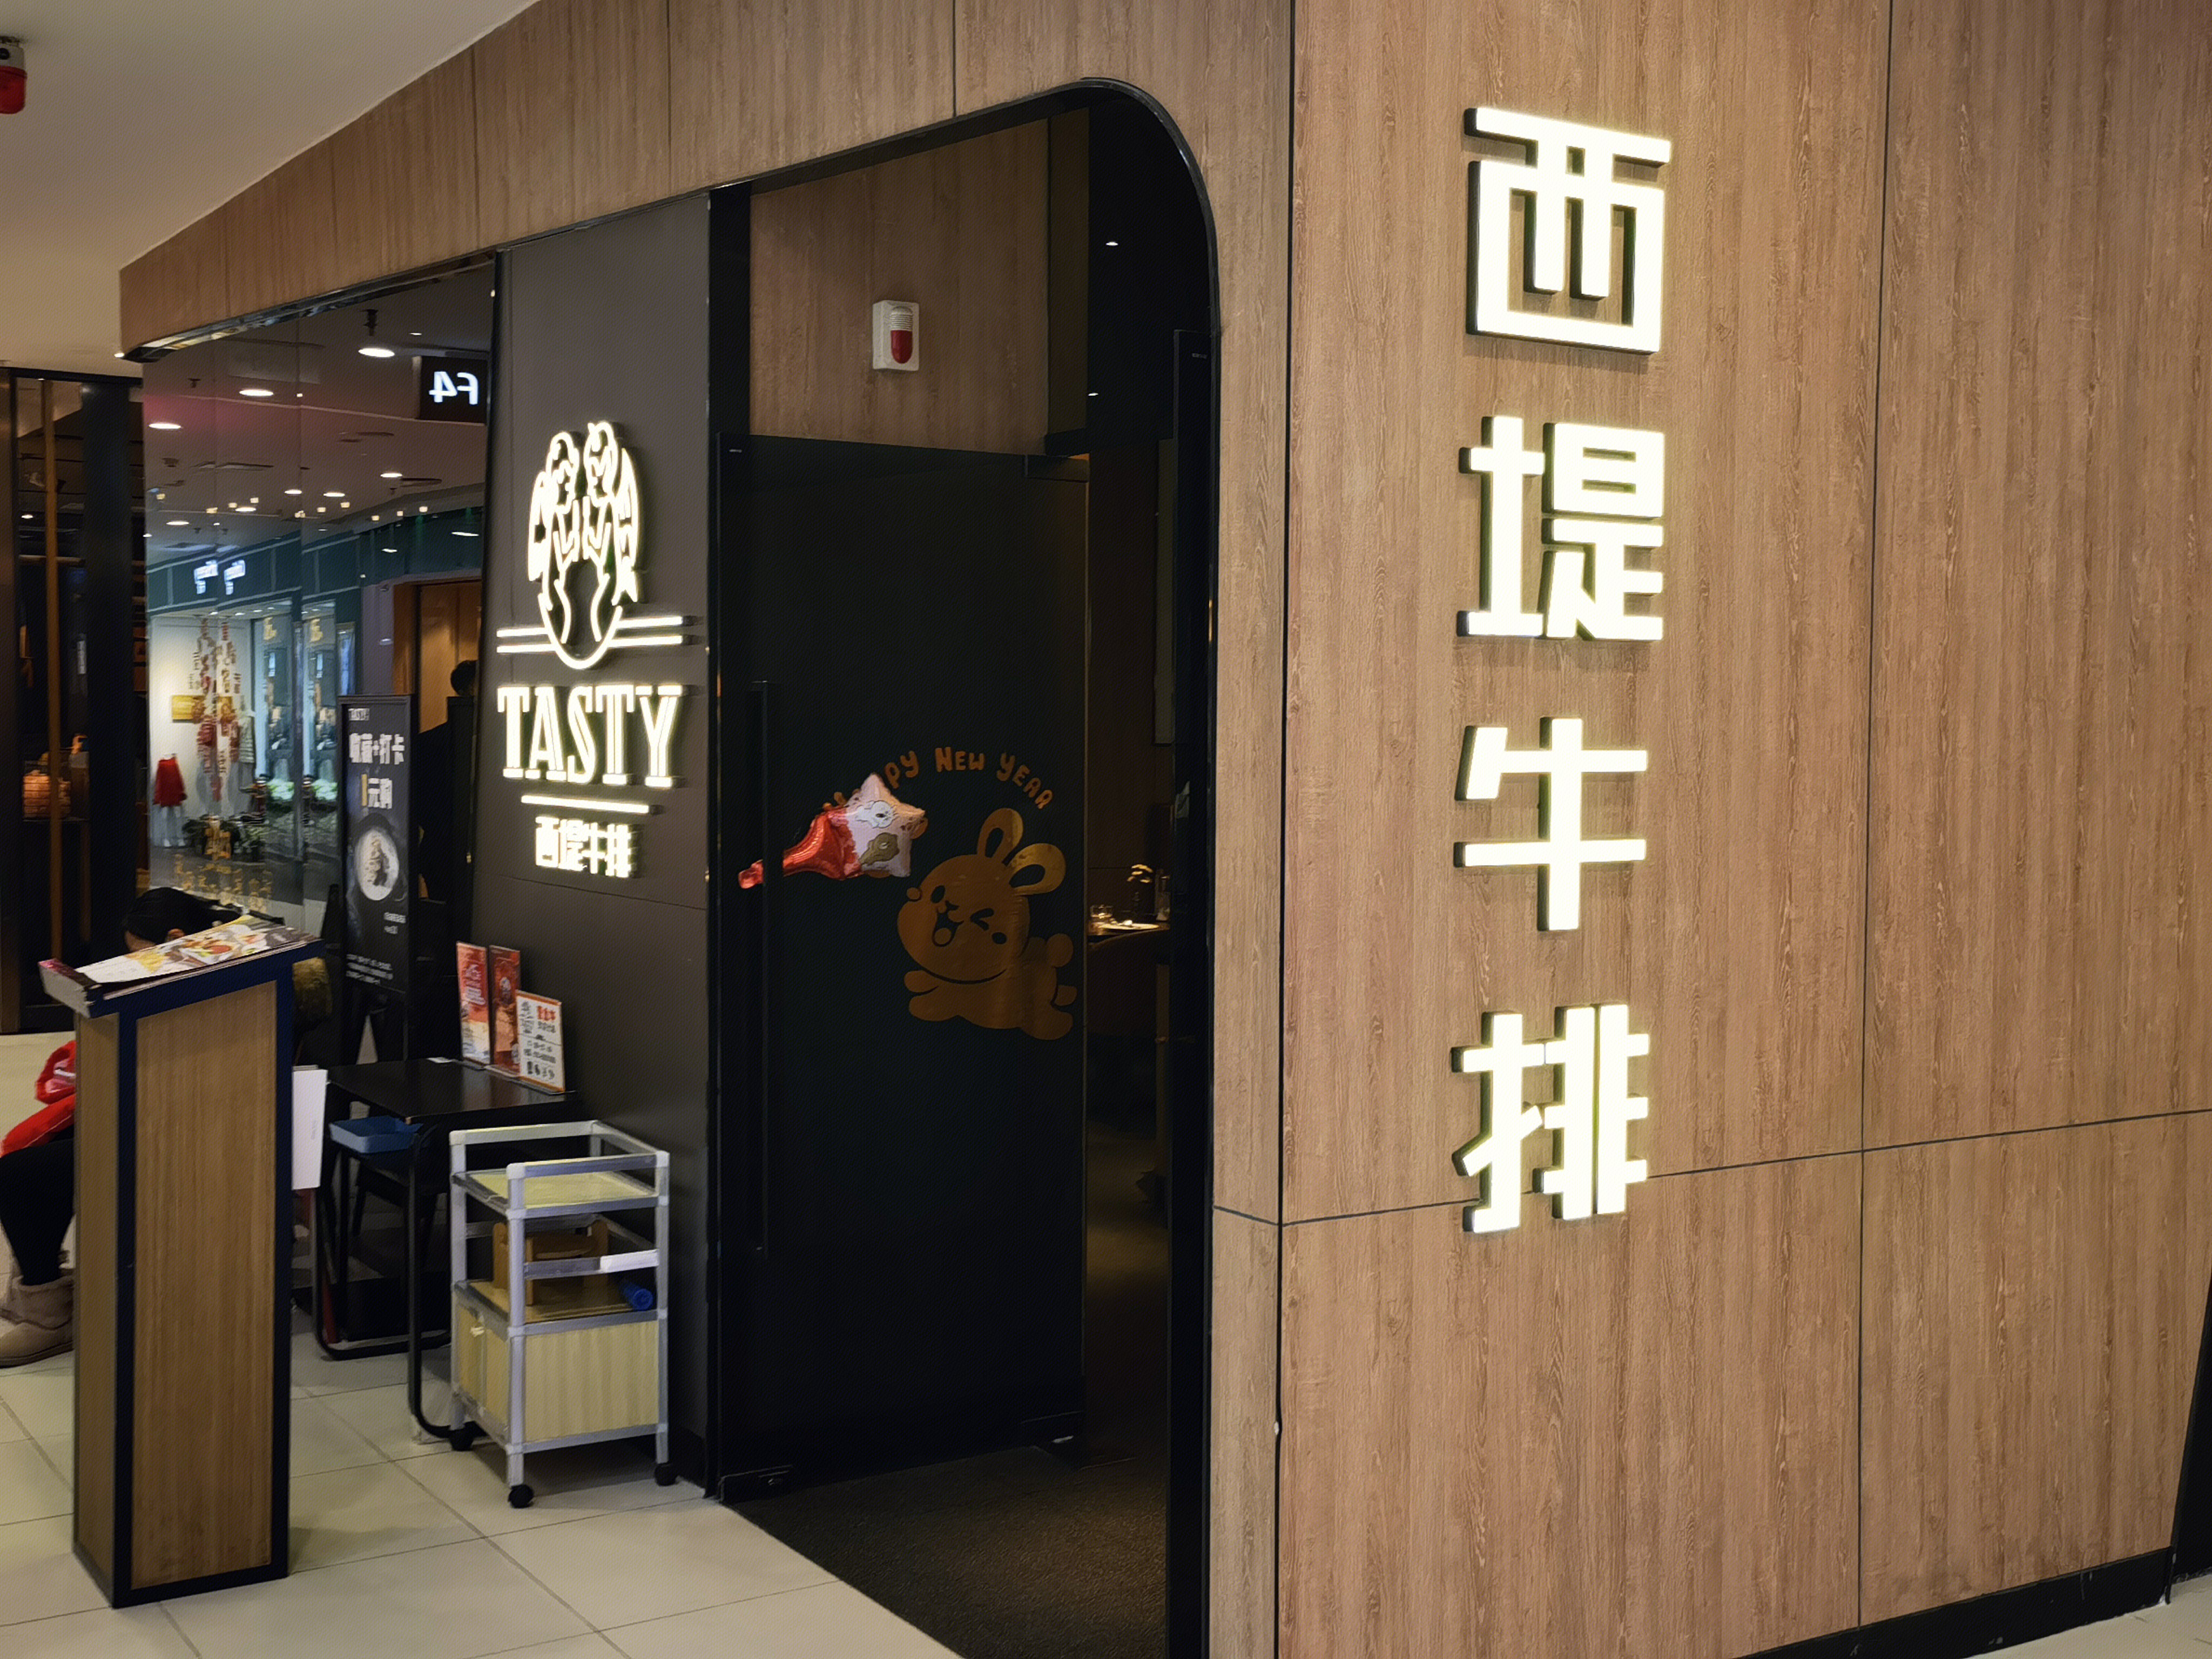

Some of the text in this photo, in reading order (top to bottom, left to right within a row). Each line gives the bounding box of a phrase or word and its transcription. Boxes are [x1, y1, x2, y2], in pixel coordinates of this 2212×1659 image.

[1456, 106, 1671, 1236] 西堤牛排
[496, 683, 683, 789] TASTY
[935, 746, 986, 772] NEW
